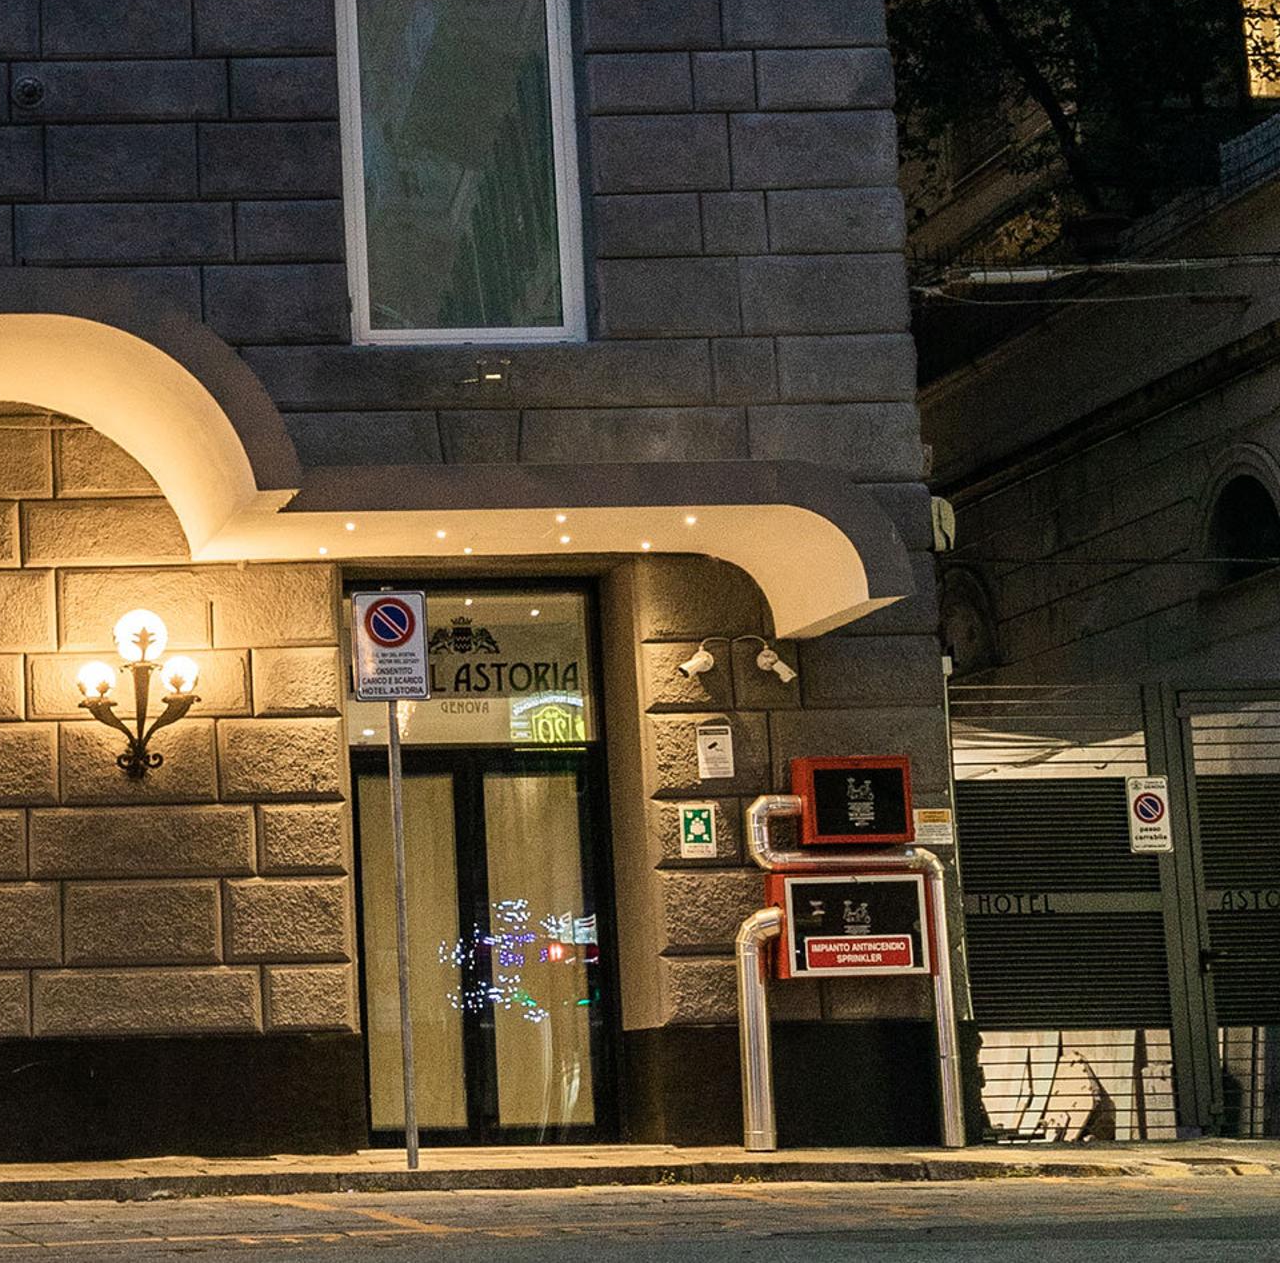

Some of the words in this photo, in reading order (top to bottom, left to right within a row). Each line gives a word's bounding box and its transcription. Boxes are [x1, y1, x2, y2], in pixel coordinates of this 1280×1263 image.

[371, 667, 413, 675] ONSENTITO
[453, 661, 579, 692] ASTORIA
[362, 676, 387, 685] CARICO
[394, 676, 424, 685] SCARICO
[362, 687, 388, 695] HOTEL
[389, 686, 425, 695] ASTORIA
[440, 700, 490, 715] GENOVA
[978, 893, 1057, 915] HOTEL
[1220, 890, 1280, 913] ASTO
[811, 942, 851, 953] IMPIANTO
[851, 941, 906, 952] ANTINCENDIO
[836, 953, 882, 963] SPRINKLER
